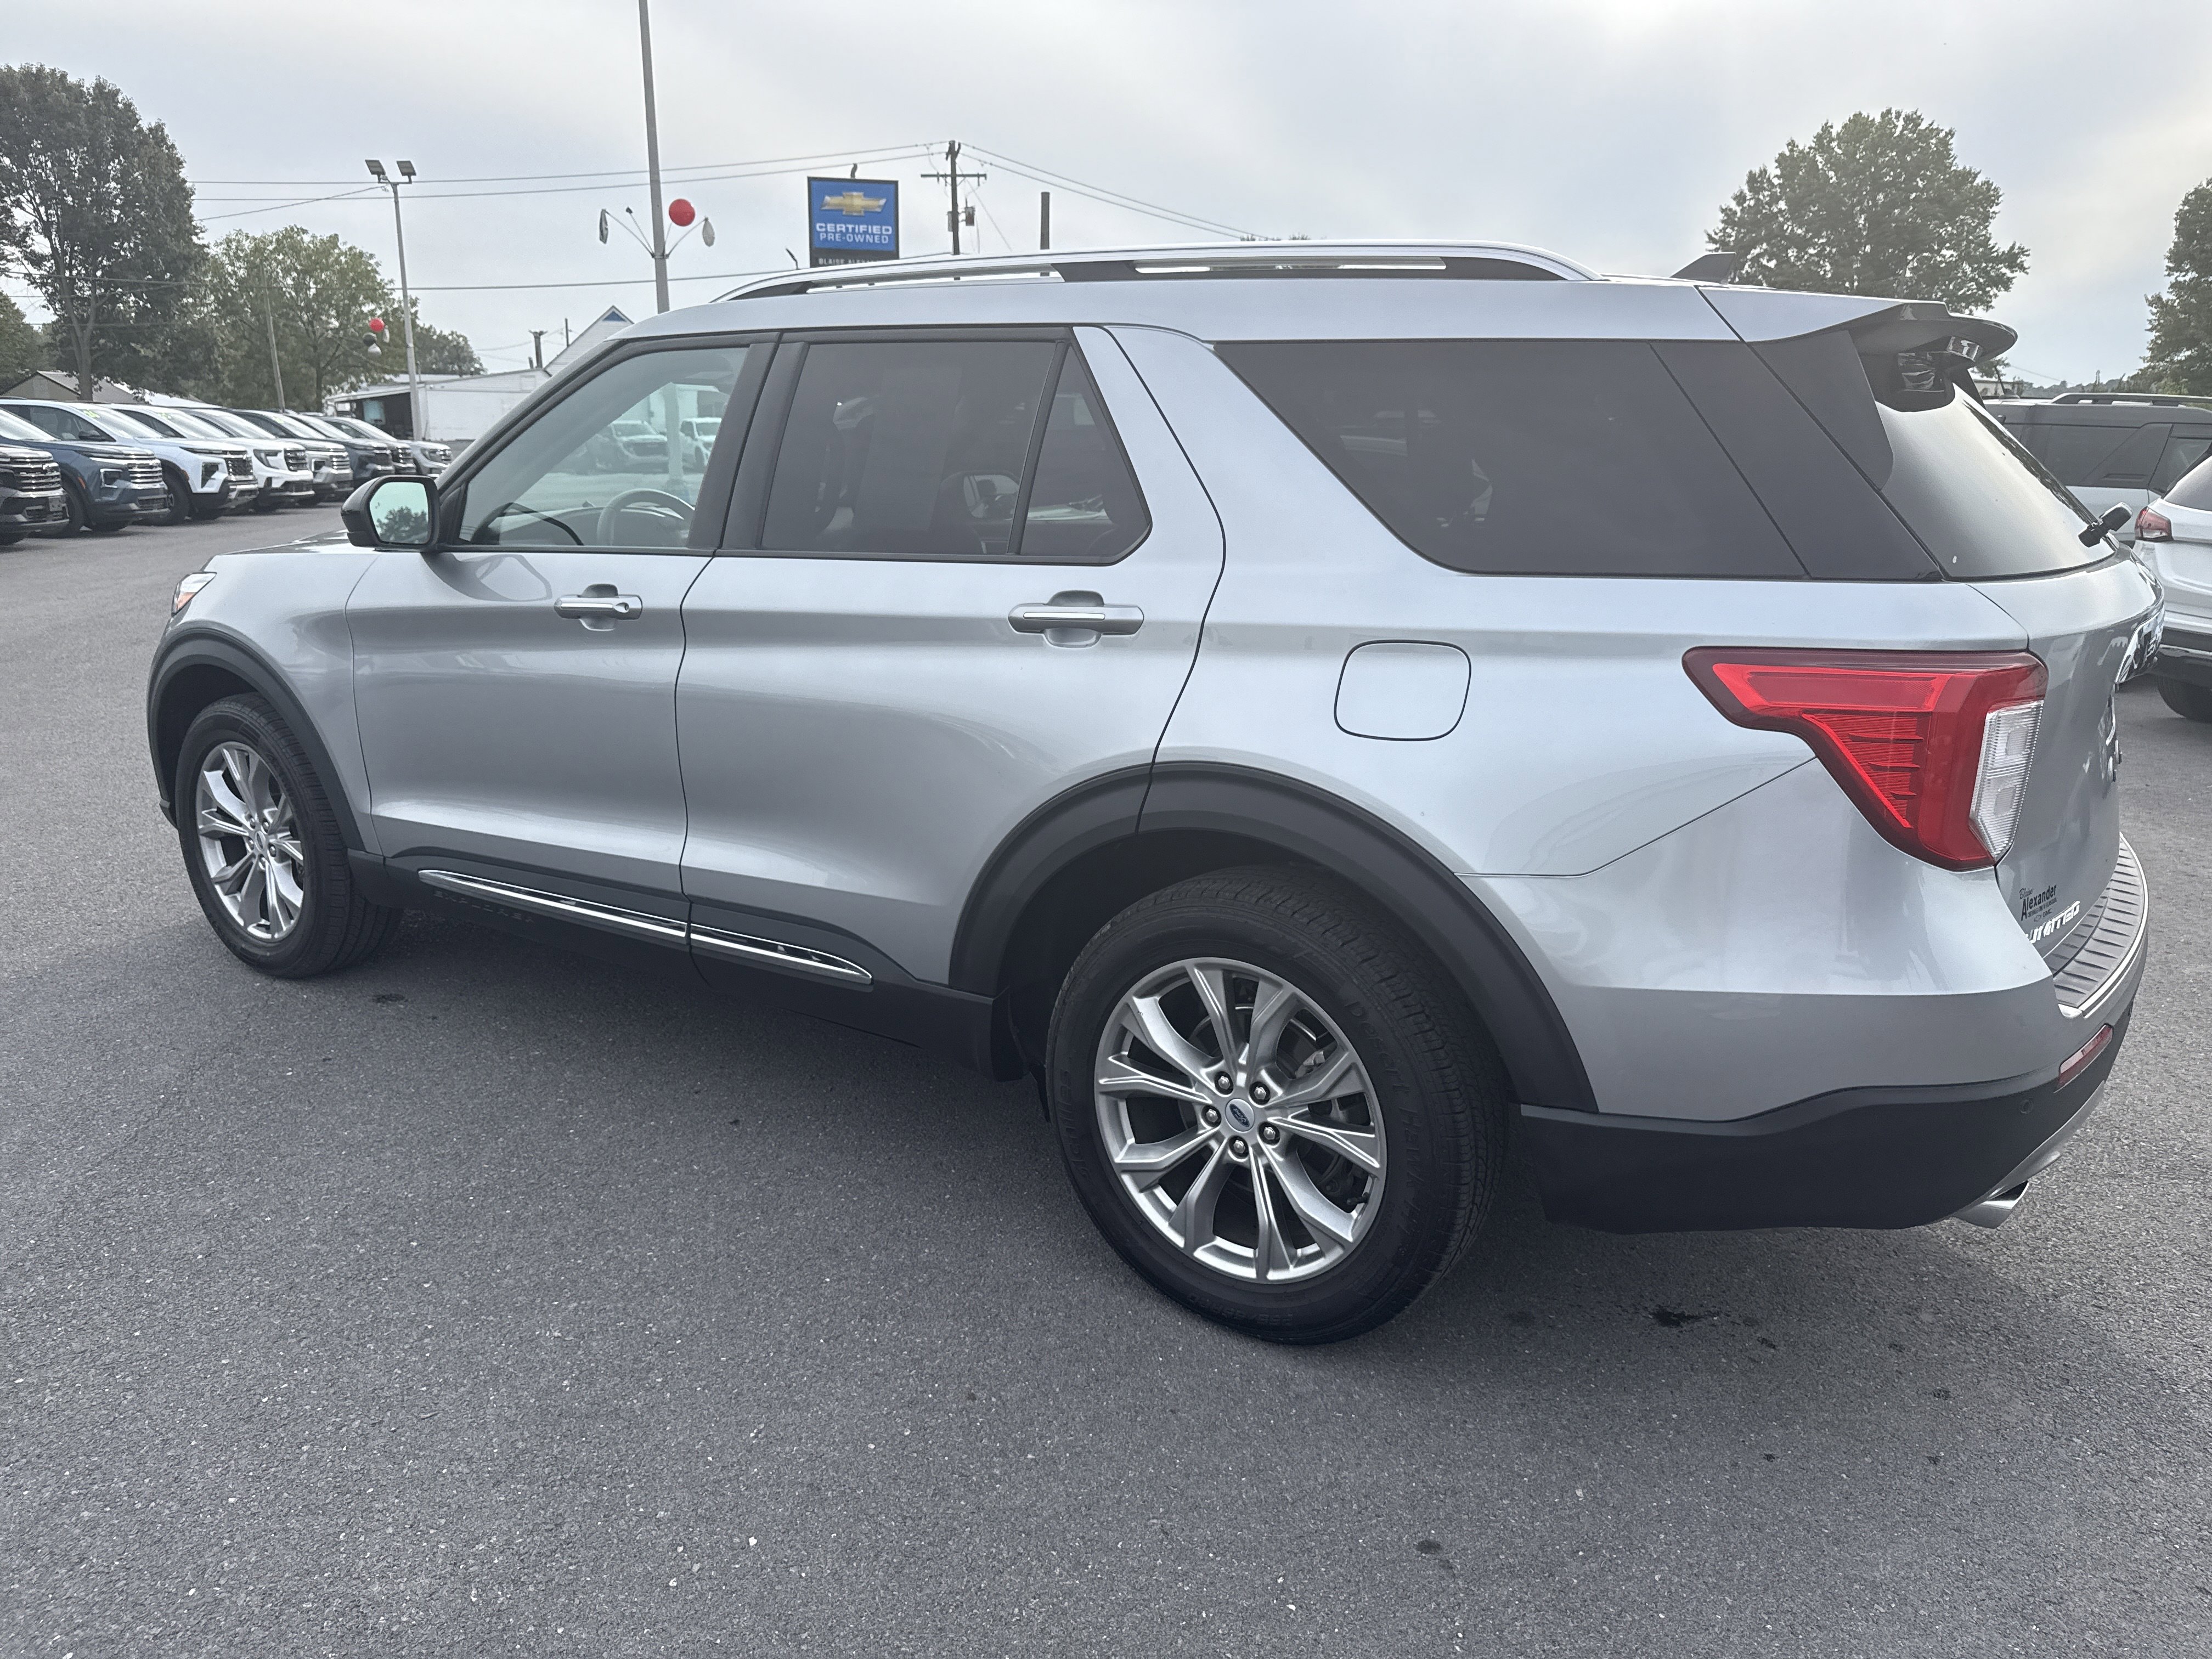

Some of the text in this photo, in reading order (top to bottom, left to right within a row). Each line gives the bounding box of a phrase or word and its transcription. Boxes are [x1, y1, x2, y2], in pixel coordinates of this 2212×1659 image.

[816, 223, 892, 235] CERTIFIED
[819, 232, 889, 244] PRE-OWNED
[2021, 884, 2057, 922] Alexander
